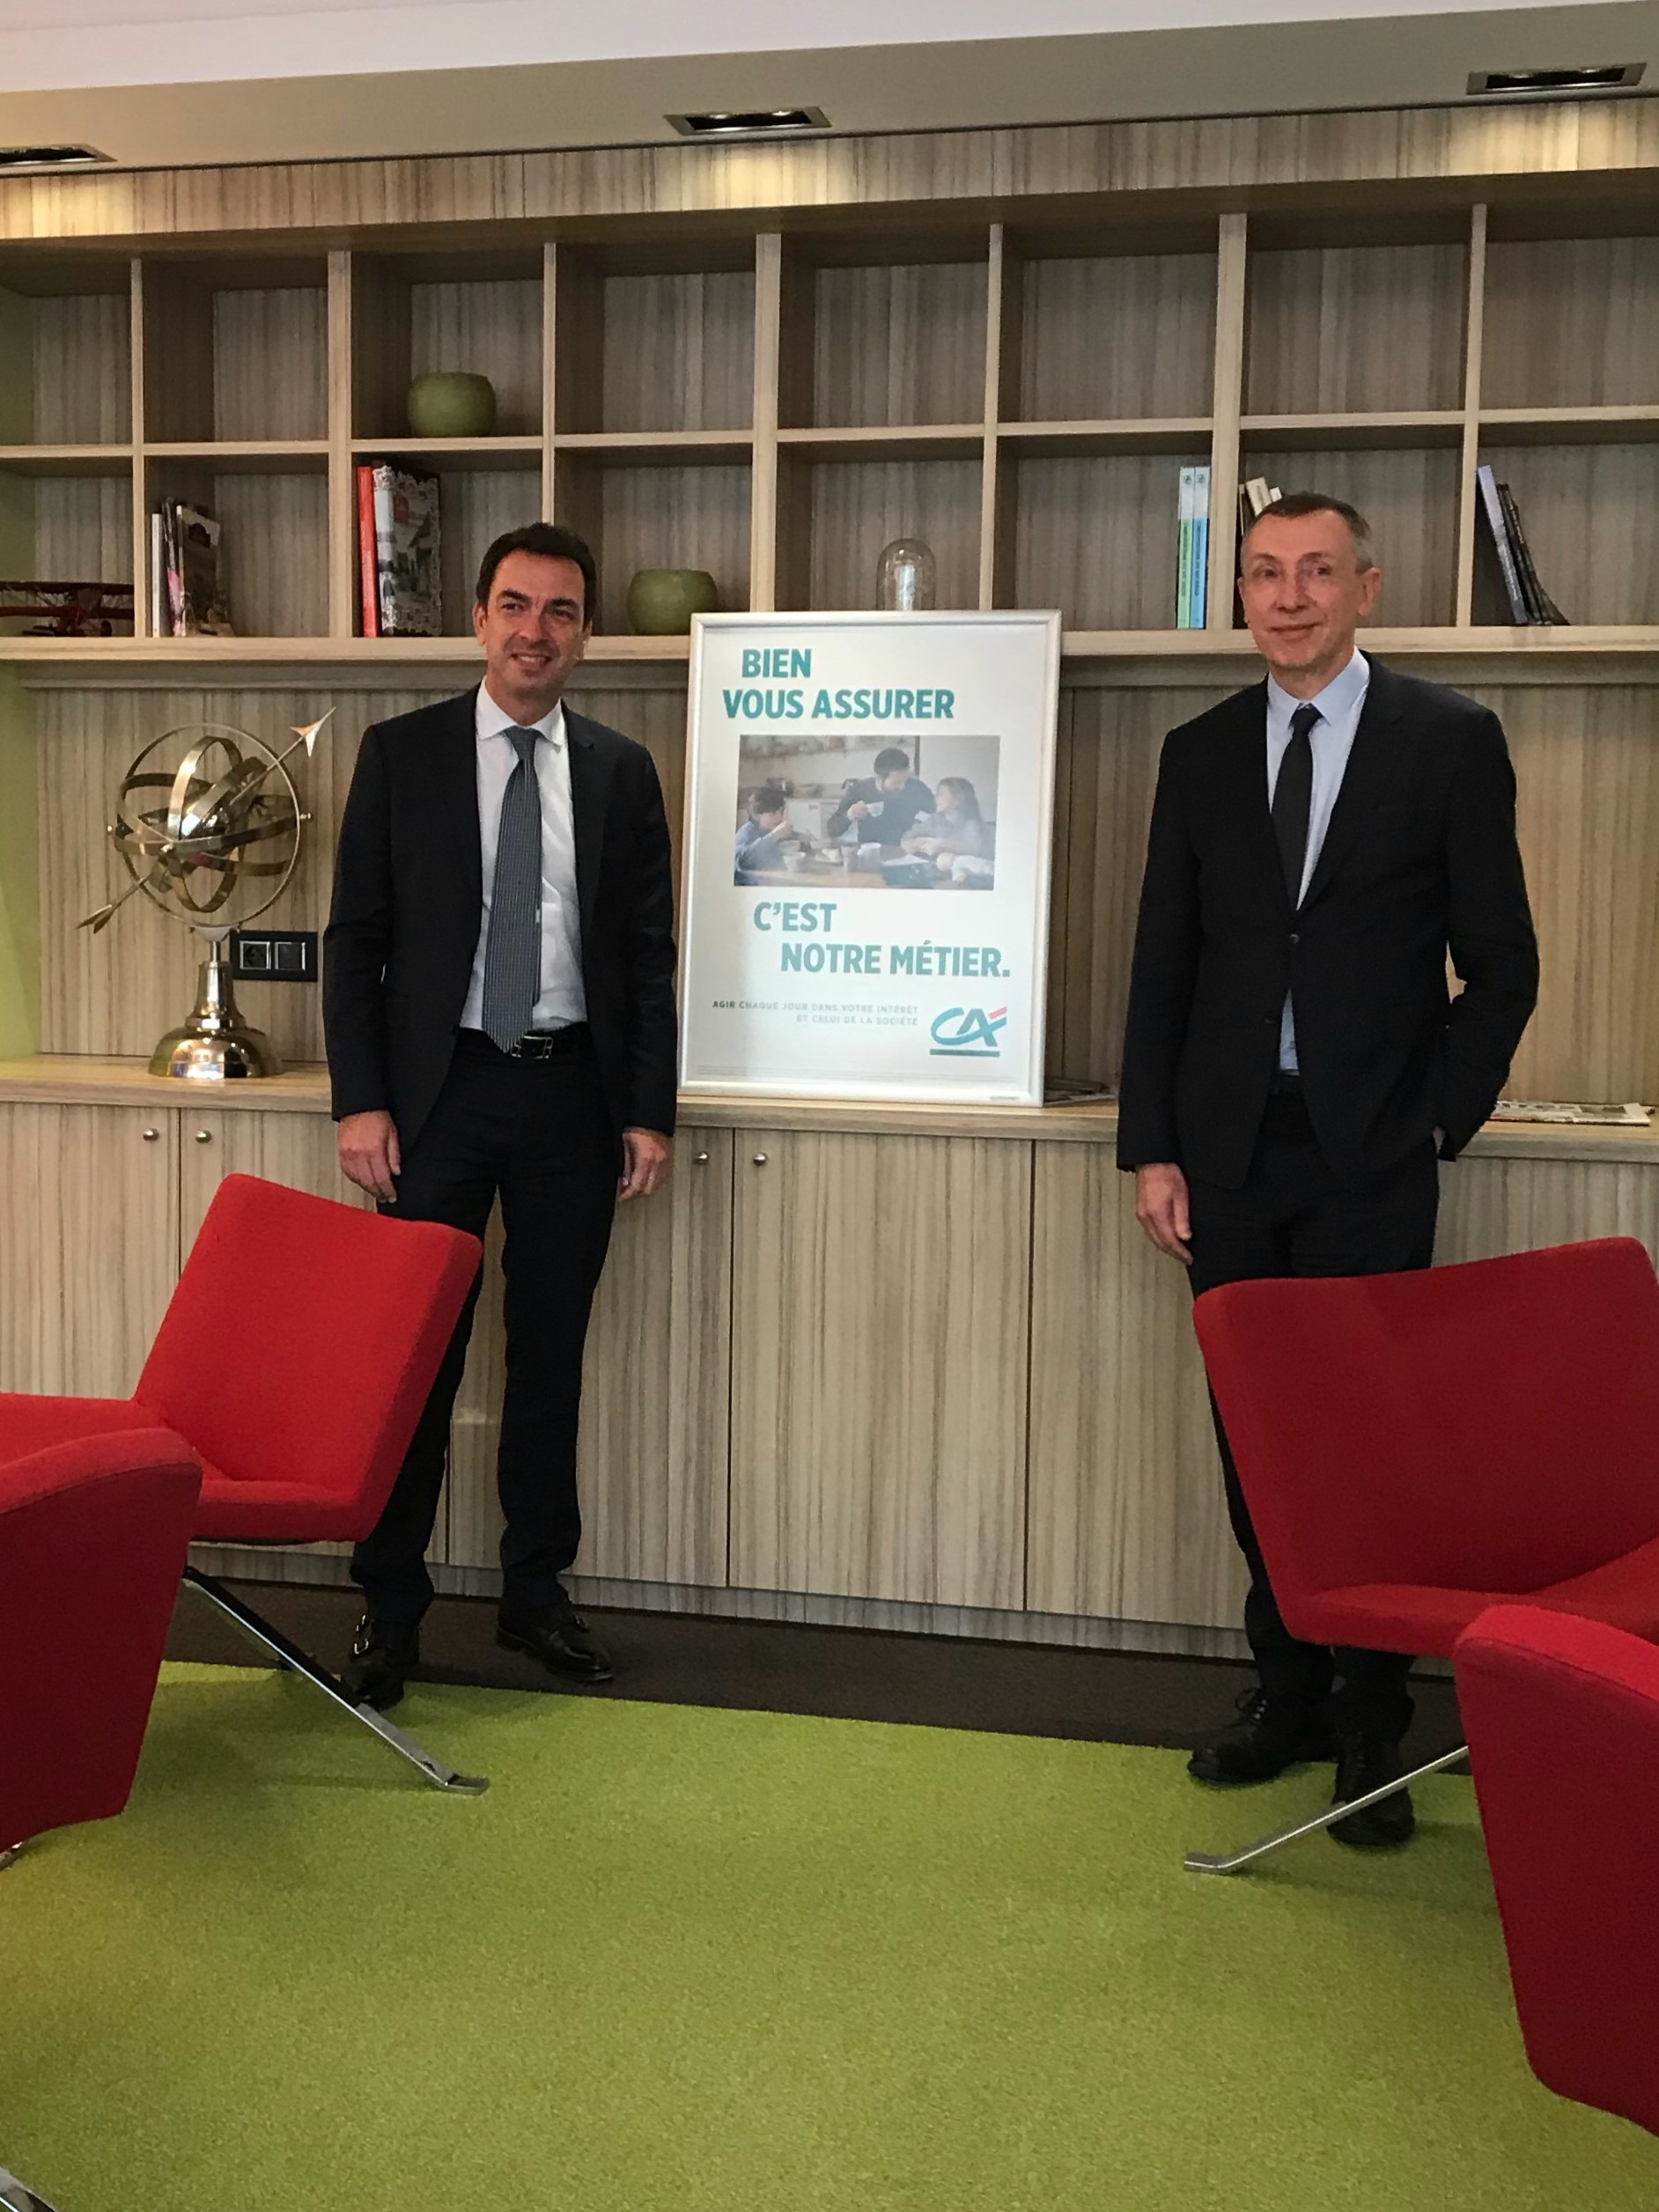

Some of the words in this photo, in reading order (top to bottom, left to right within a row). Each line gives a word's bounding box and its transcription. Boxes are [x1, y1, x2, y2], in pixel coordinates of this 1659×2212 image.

[741, 648, 812, 678] BIEN
[722, 689, 804, 719] VOUS
[811, 689, 955, 719] ASSURER
[754, 902, 837, 932] C'EST
[781, 942, 881, 974] NOTRE
[889, 940, 1010, 977] MÉTIER.
[712, 1000, 736, 1009] AGIR
[738, 1001, 779, 1011] CHAQUE
[782, 1002, 807, 1011] JOUR
[811, 1003, 838, 1012] DANS
[841, 1004, 874, 1014] VOTRE
[796, 1014, 809, 1023] ET
[812, 1014, 840, 1023] CELUI
[844, 1015, 856, 1024] DE
[859, 1016, 873, 1025] LA
[930, 1006, 1007, 1048] CA
